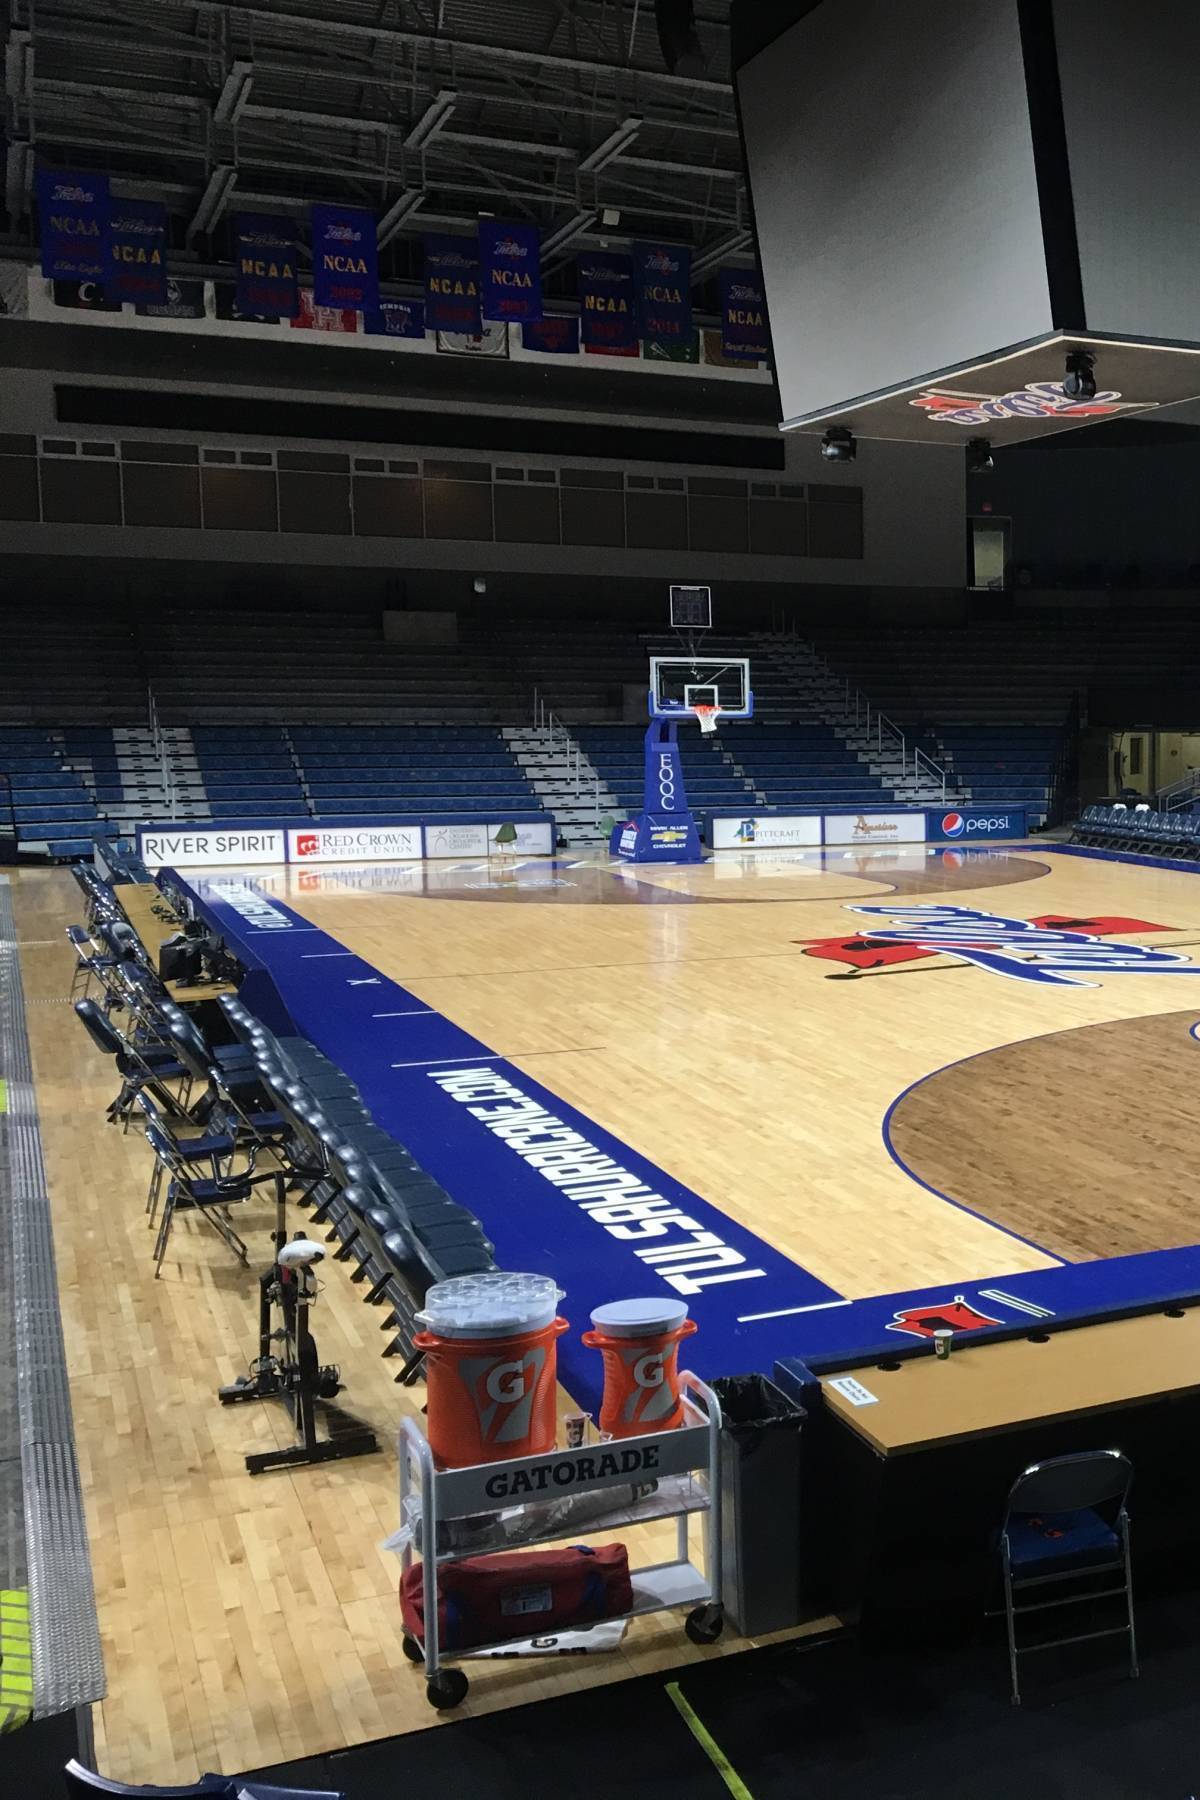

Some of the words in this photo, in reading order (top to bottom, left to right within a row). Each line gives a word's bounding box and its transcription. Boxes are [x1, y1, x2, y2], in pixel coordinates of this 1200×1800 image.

[50, 215, 100, 236] NCAA
[112, 245, 161, 265] NCAA
[323, 255, 368, 274] NCAA
[240, 258, 293, 279] NCAA
[491, 269, 533, 288] NCAA
[429, 276, 477, 297] NCAA
[643, 287, 682, 304] NCAA
[584, 295, 628, 313] NCAA
[728, 308, 763, 327] NCAA
[658, 753, 675, 811] EOOC
[755, 829, 800, 838] PITTCRAFT
[966, 815, 1009, 833] pepsi
[145, 837, 209, 861] RIVER
[215, 835, 275, 852] SPIRIT
[322, 833, 355, 847] RED
[357, 832, 412, 846] CROWN
[321, 847, 370, 856] CREDIT
[373, 845, 413, 854] UNION
[427, 1067, 767, 1295] TULSAHURRICANE.COM
[634, 1353, 664, 1388] G
[487, 1360, 524, 1403] G
[485, 1444, 660, 1498] GATORADE
